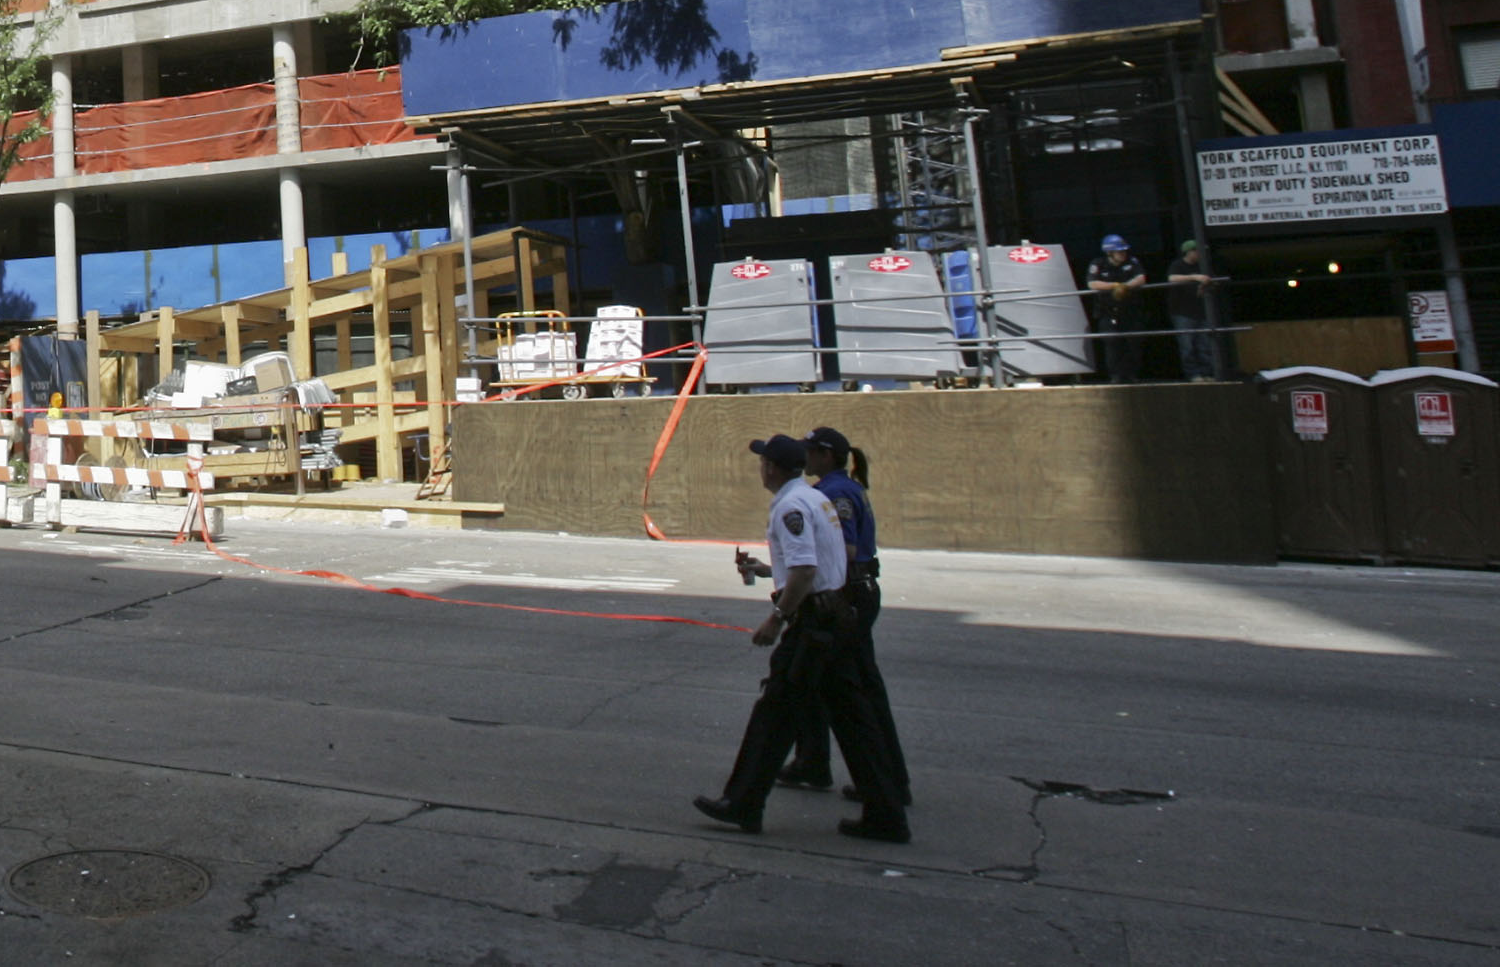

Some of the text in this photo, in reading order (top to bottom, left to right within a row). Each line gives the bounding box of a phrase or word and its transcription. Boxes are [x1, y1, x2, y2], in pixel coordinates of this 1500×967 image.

[1202, 138, 1435, 165] YORK SCAFFOLD EQUIPMENT CORP.
[1249, 164, 1278, 177] STREET
[1232, 171, 1410, 194] HEAVY DUTY SIDEWALK SHED
[1204, 198, 1239, 211] PERMIT
[1312, 190, 1368, 205] EXPIRATION
[1371, 188, 1395, 201] DATE
[1261, 210, 1304, 220] MATERIAL
[1307, 209, 1324, 218] NOT
[1327, 205, 1377, 217] PERMITTED
[1379, 205, 1392, 214] ON
[1395, 203, 1416, 213] THIS
[1419, 202, 1442, 212] SHED
